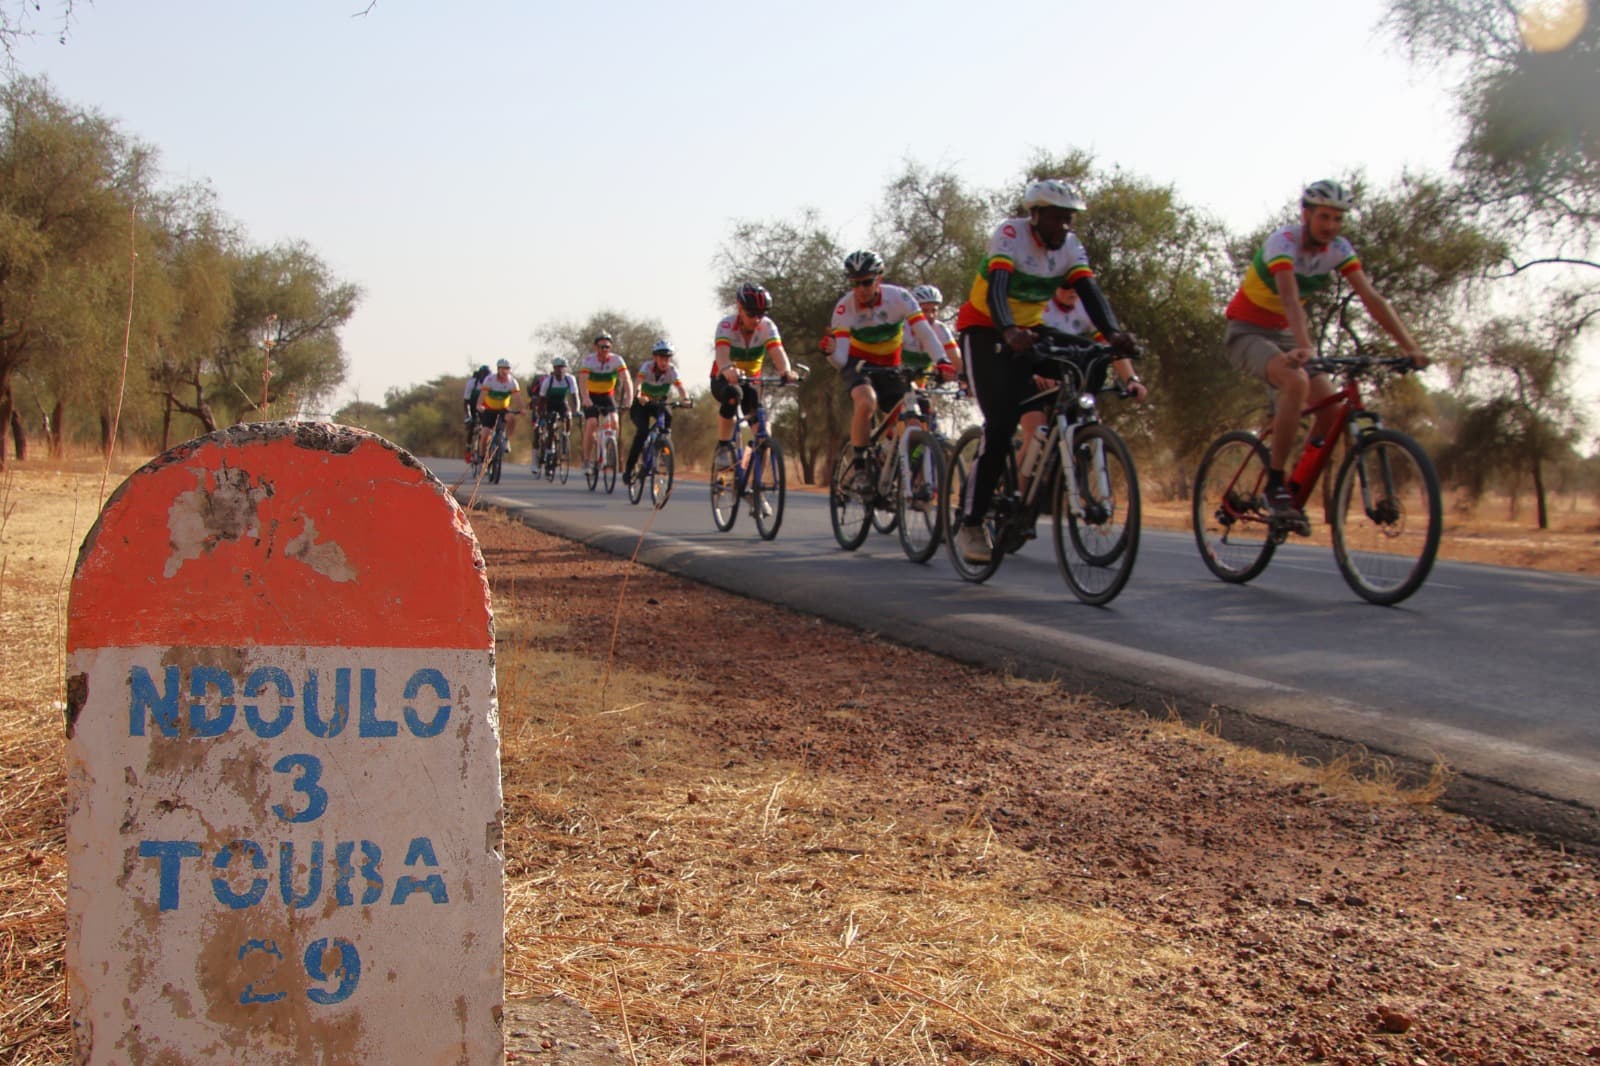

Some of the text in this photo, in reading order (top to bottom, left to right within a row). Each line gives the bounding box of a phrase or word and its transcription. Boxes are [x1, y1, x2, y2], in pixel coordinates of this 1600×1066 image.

[129, 665, 452, 739] NDOULO
[271, 753, 329, 823] 3
[139, 836, 449, 911] TOUBA
[238, 937, 361, 1005] 29
